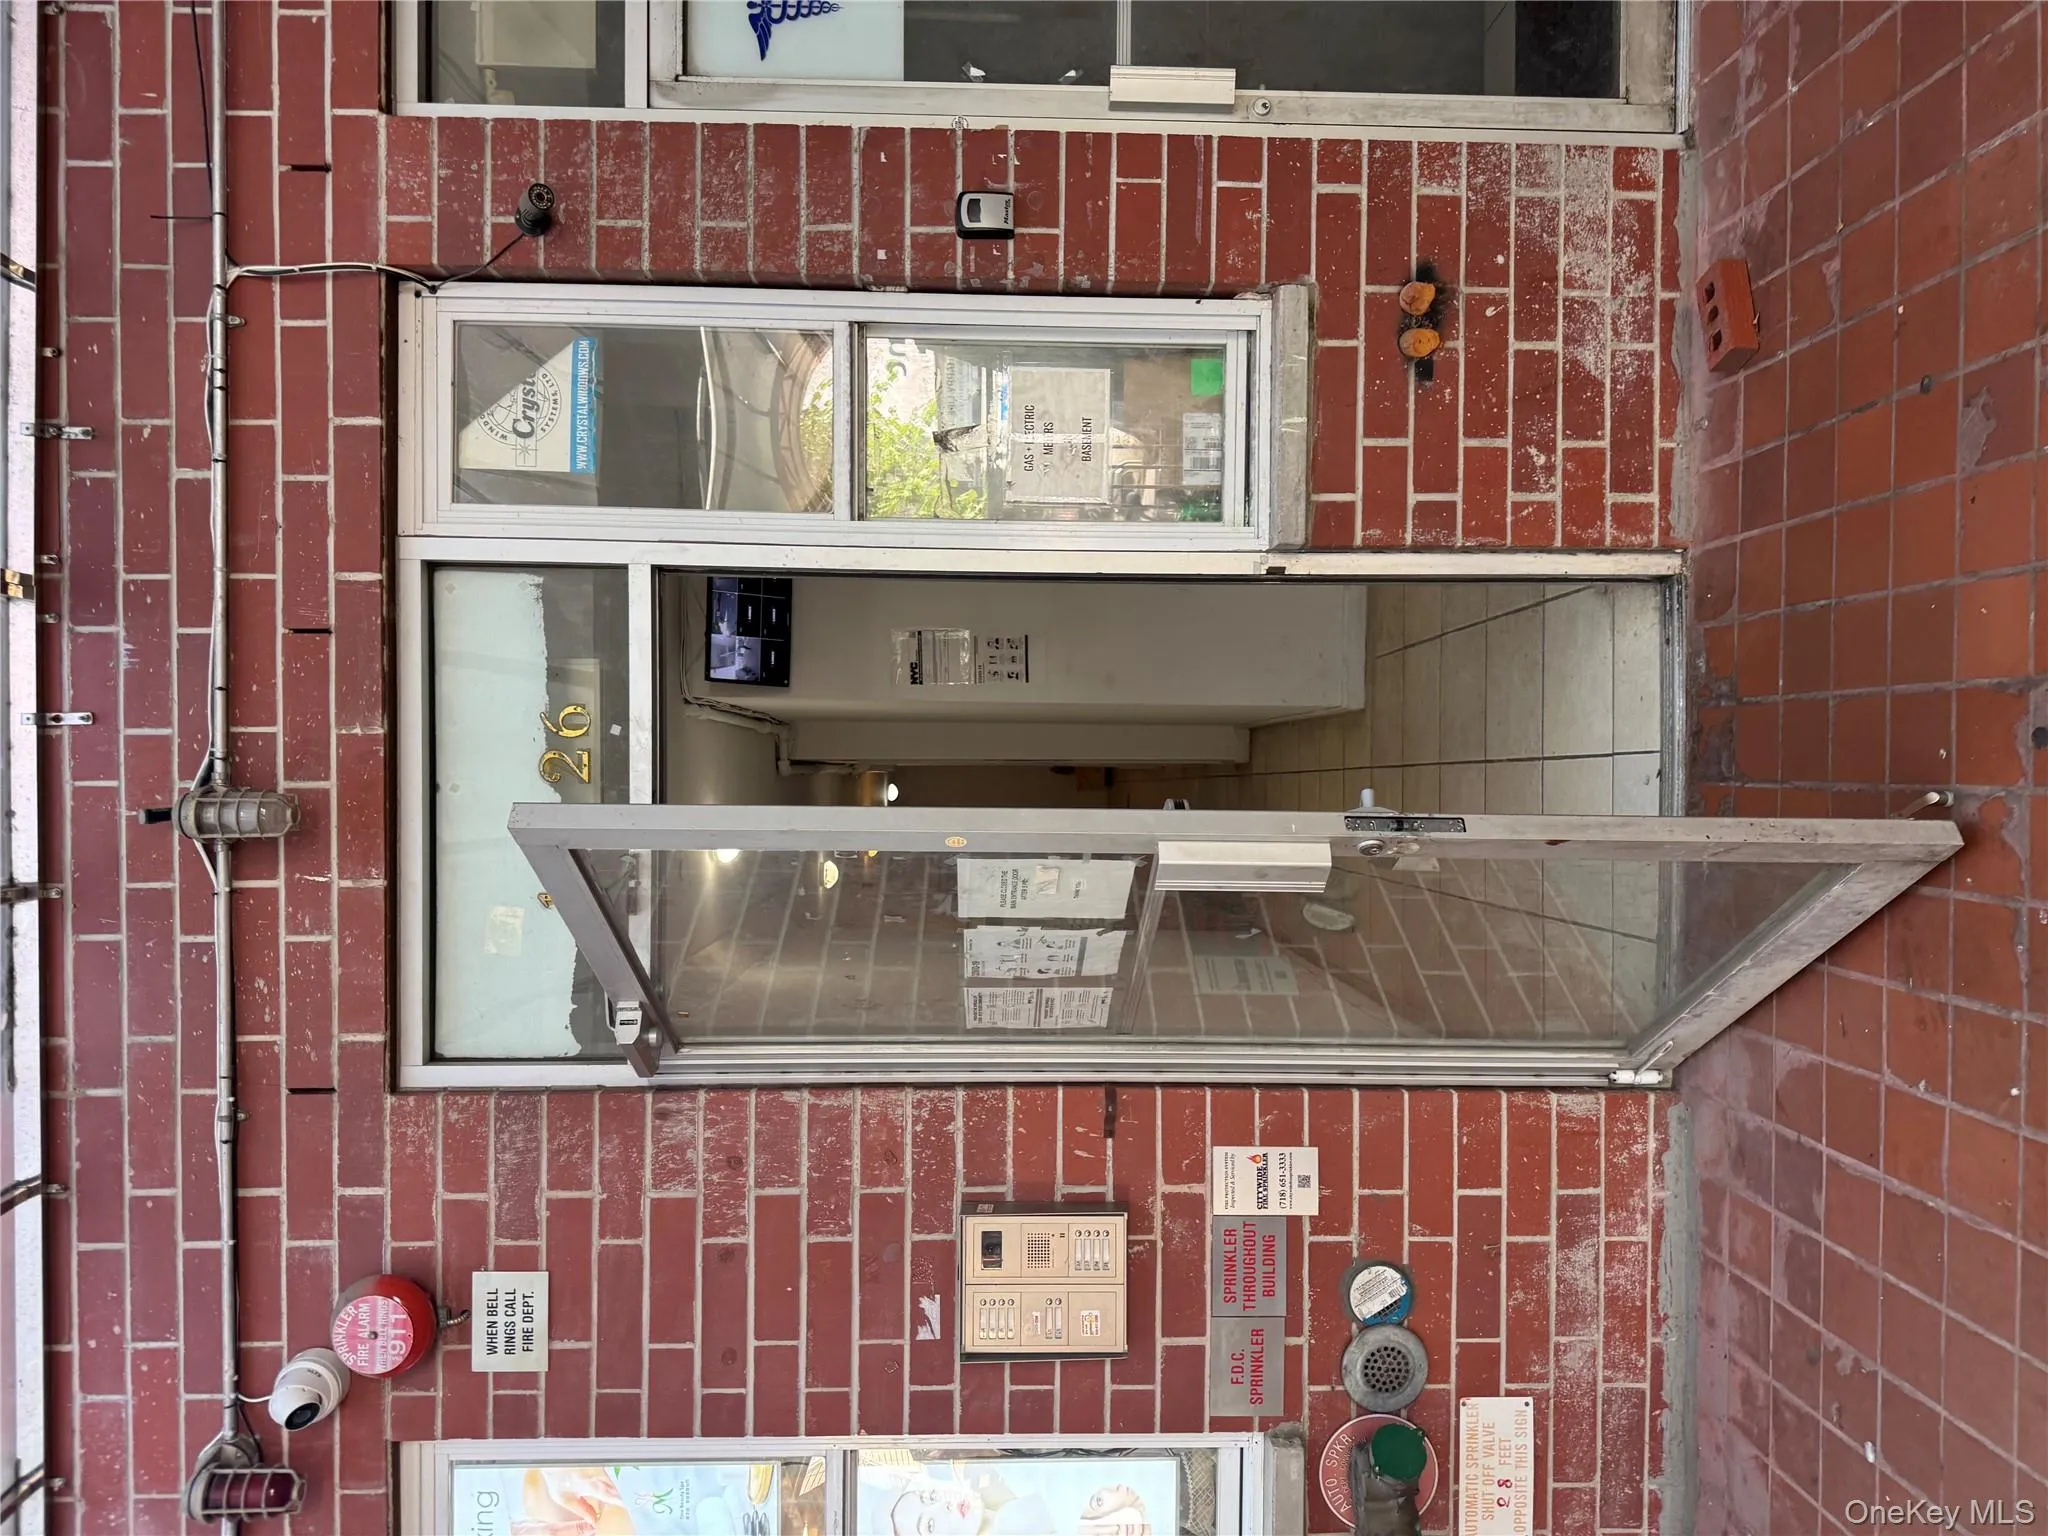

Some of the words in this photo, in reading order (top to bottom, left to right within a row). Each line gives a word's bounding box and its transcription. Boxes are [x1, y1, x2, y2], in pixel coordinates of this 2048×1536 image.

[575, 340, 590, 470] WWW.CRYSTALWINDOWS.COM
[1024, 454, 1034, 472] GAS
[910, 662, 918, 685] NYC
[538, 704, 592, 785] 26
[1279, 1190, 1287, 1209] (718)
[1223, 1228, 1237, 1304] SPRINKLER
[1243, 1221, 1257, 1312] THROUGHOUT
[1262, 1235, 1276, 1297] BUILDING
[486, 1288, 498, 1316] BELL
[504, 1288, 516, 1317] CALL
[522, 1291, 534, 1323] DEPT.
[333, 1305, 358, 1365] SPRINKLER
[358, 1303, 370, 1338] ALARM
[389, 1314, 407, 1355] 911
[358, 1343, 369, 1366] FIRE
[486, 1321, 498, 1355] WHEN
[504, 1321, 516, 1355] RINGS
[522, 1327, 534, 1352] FIRE
[1231, 1349, 1245, 1385] F.D.C.
[1250, 1328, 1264, 1405] SPRINKLER
[1466, 1403, 1479, 1468] SPRINKLER
[1483, 1422, 1495, 1457] VALVE
[1515, 1409, 1528, 1438] SIGN
[1326, 1434, 1355, 1467] SPKR.
[1498, 1438, 1511, 1466] FEET
[1515, 1443, 1528, 1470] THIS
[1482, 1464, 1495, 1486] OFF
[1325, 1474, 1352, 1513] AUTO.
[1465, 1474, 1479, 1536] AUTOMATIC
[1482, 1491, 1495, 1520] SHUT
[1514, 1476, 1528, 1532] OPPOSITE
